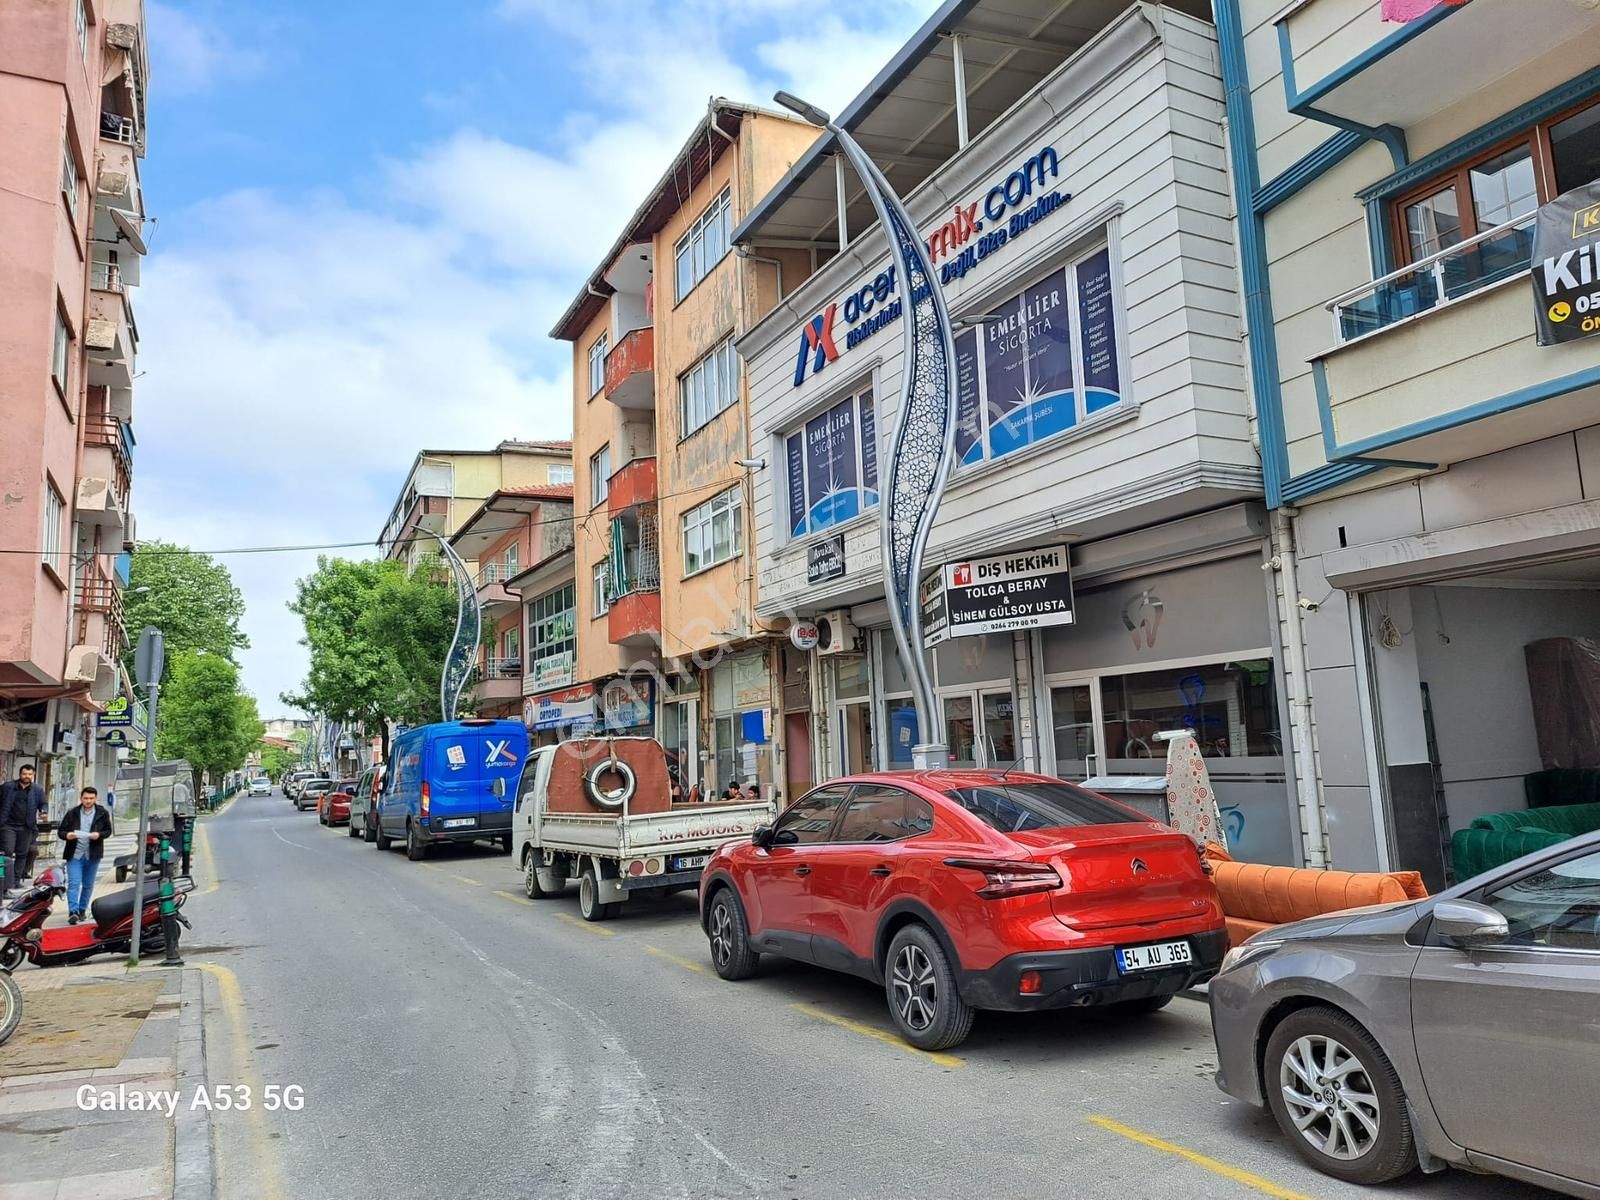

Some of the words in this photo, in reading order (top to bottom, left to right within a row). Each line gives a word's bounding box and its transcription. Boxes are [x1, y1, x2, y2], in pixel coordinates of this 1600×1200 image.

[977, 228, 1007, 260] Bize
[989, 289, 1061, 343] EMEKLİER
[999, 317, 1052, 356] SİGORTA
[809, 412, 851, 446] EMEKLİER
[814, 431, 846, 457] SİGORTA
[965, 584, 1004, 599] TOLGA
[1008, 577, 1048, 593] BERAY
[1003, 595, 1010, 605] &
[953, 608, 987, 623] SİNEM
[989, 603, 1033, 618] GÜLSOY
[1036, 599, 1066, 613] USTA
[687, 823, 744, 838] MOTORS
[679, 857, 687, 868] 16
[690, 856, 704, 867] AHP
[1124, 949, 1140, 968] 54
[1147, 946, 1162, 965] AU
[1166, 943, 1189, 962] 365
